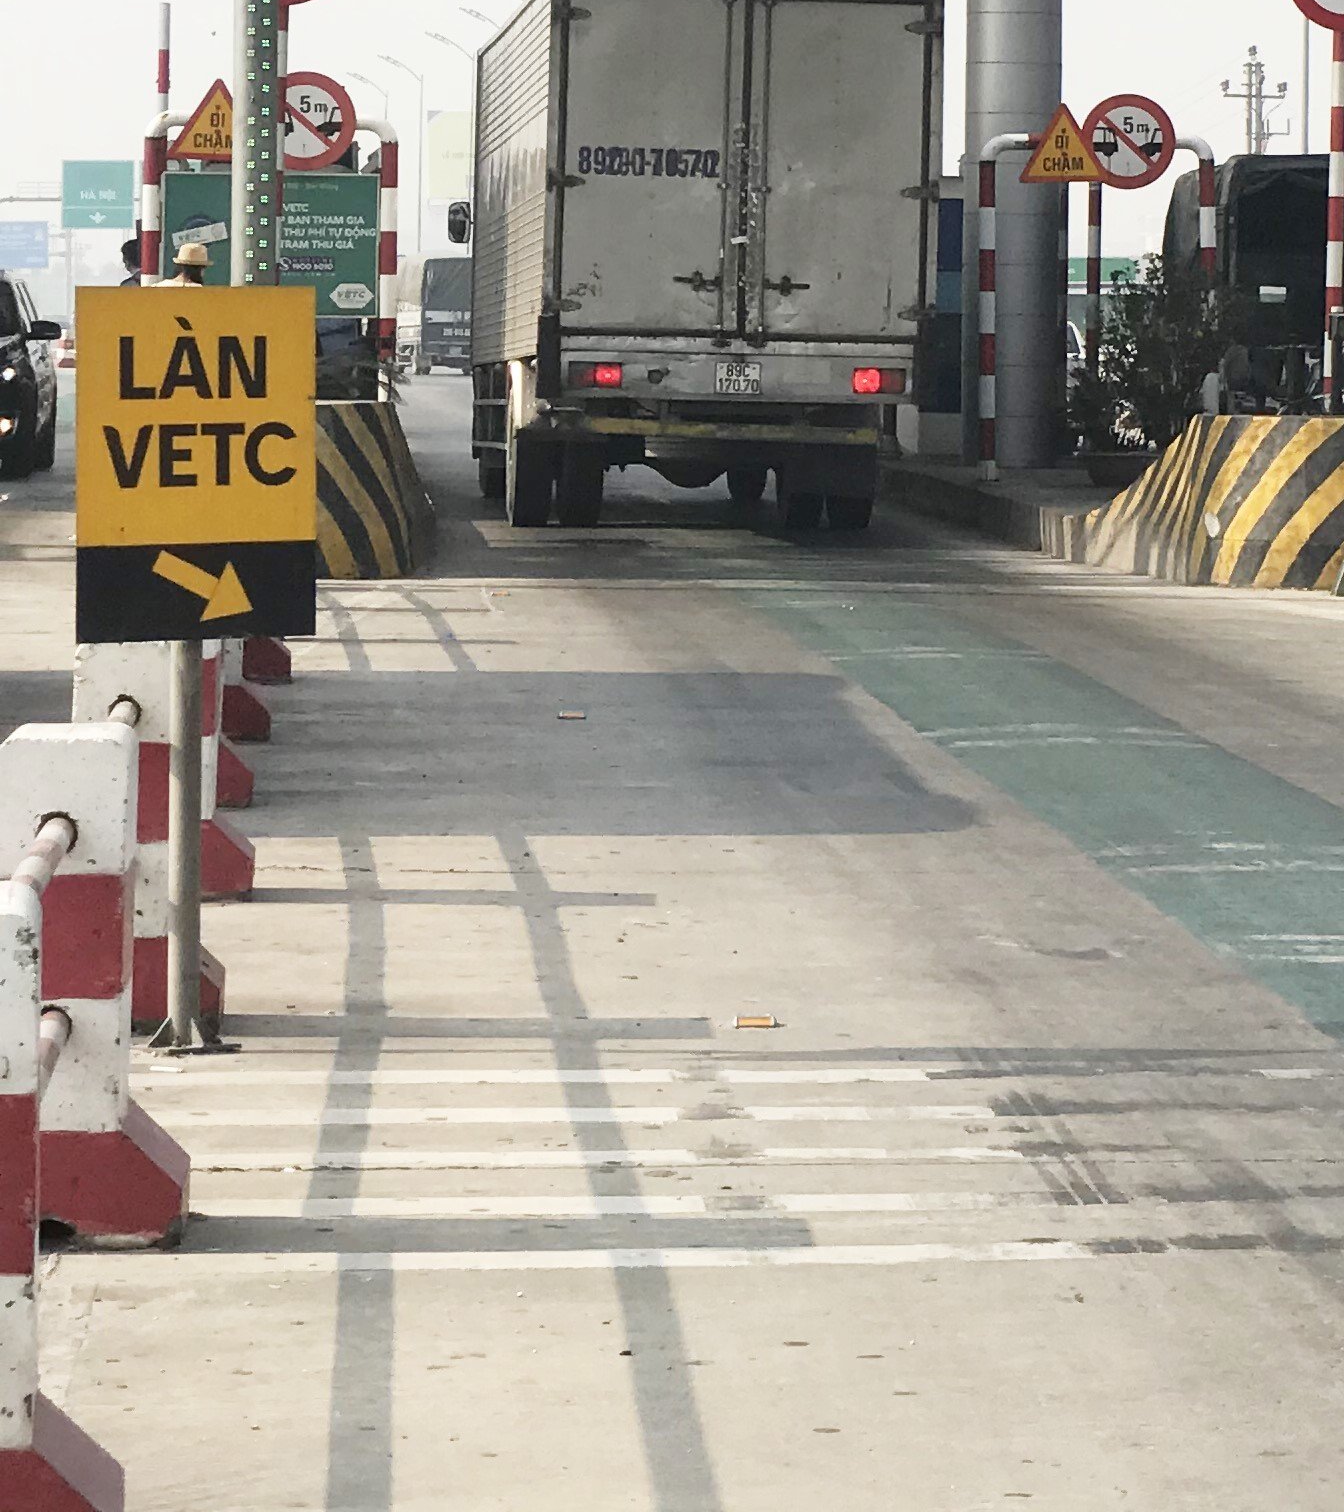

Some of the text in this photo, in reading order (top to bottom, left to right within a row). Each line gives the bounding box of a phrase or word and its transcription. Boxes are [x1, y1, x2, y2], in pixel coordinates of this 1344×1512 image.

[1043, 152, 1084, 174] CHẬM
[311, 239, 333, 249] THU
[118, 316, 268, 400] LÀN
[726, 363, 750, 377] 89C
[103, 421, 297, 489] VETC
